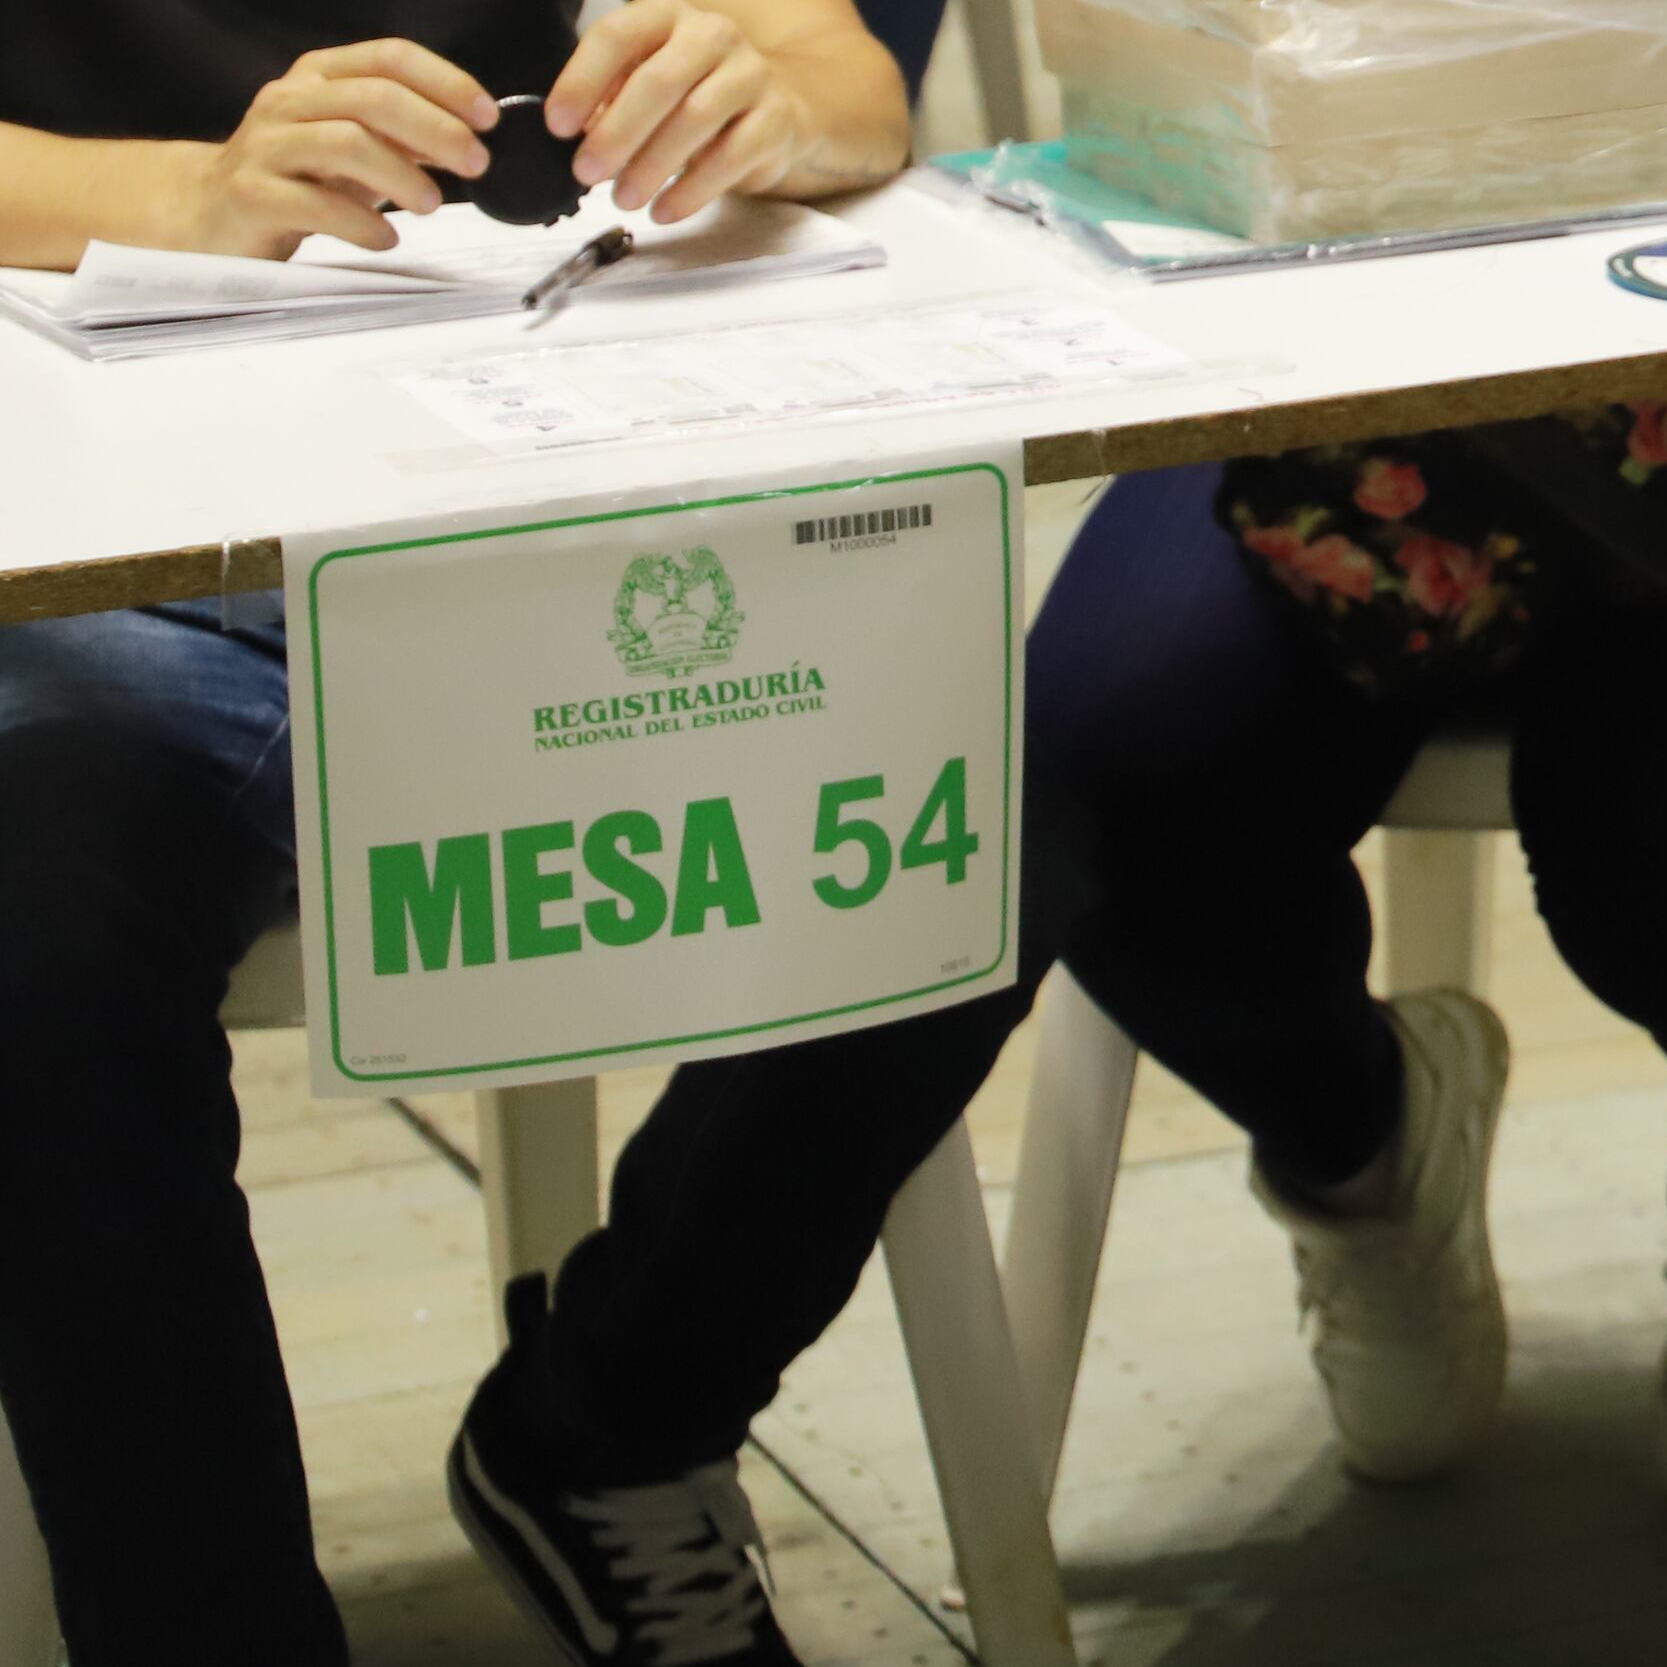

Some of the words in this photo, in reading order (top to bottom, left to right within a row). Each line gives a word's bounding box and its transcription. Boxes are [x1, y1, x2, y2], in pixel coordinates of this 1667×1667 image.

[533, 660, 826, 732] REGISTRADURÍA
[534, 724, 639, 752] NACIONAL
[645, 716, 685, 736] DEL
[692, 703, 770, 728] ESTADO
[776, 695, 827, 716] CIVIL
[368, 796, 762, 976] MESA
[811, 755, 980, 911] 54
